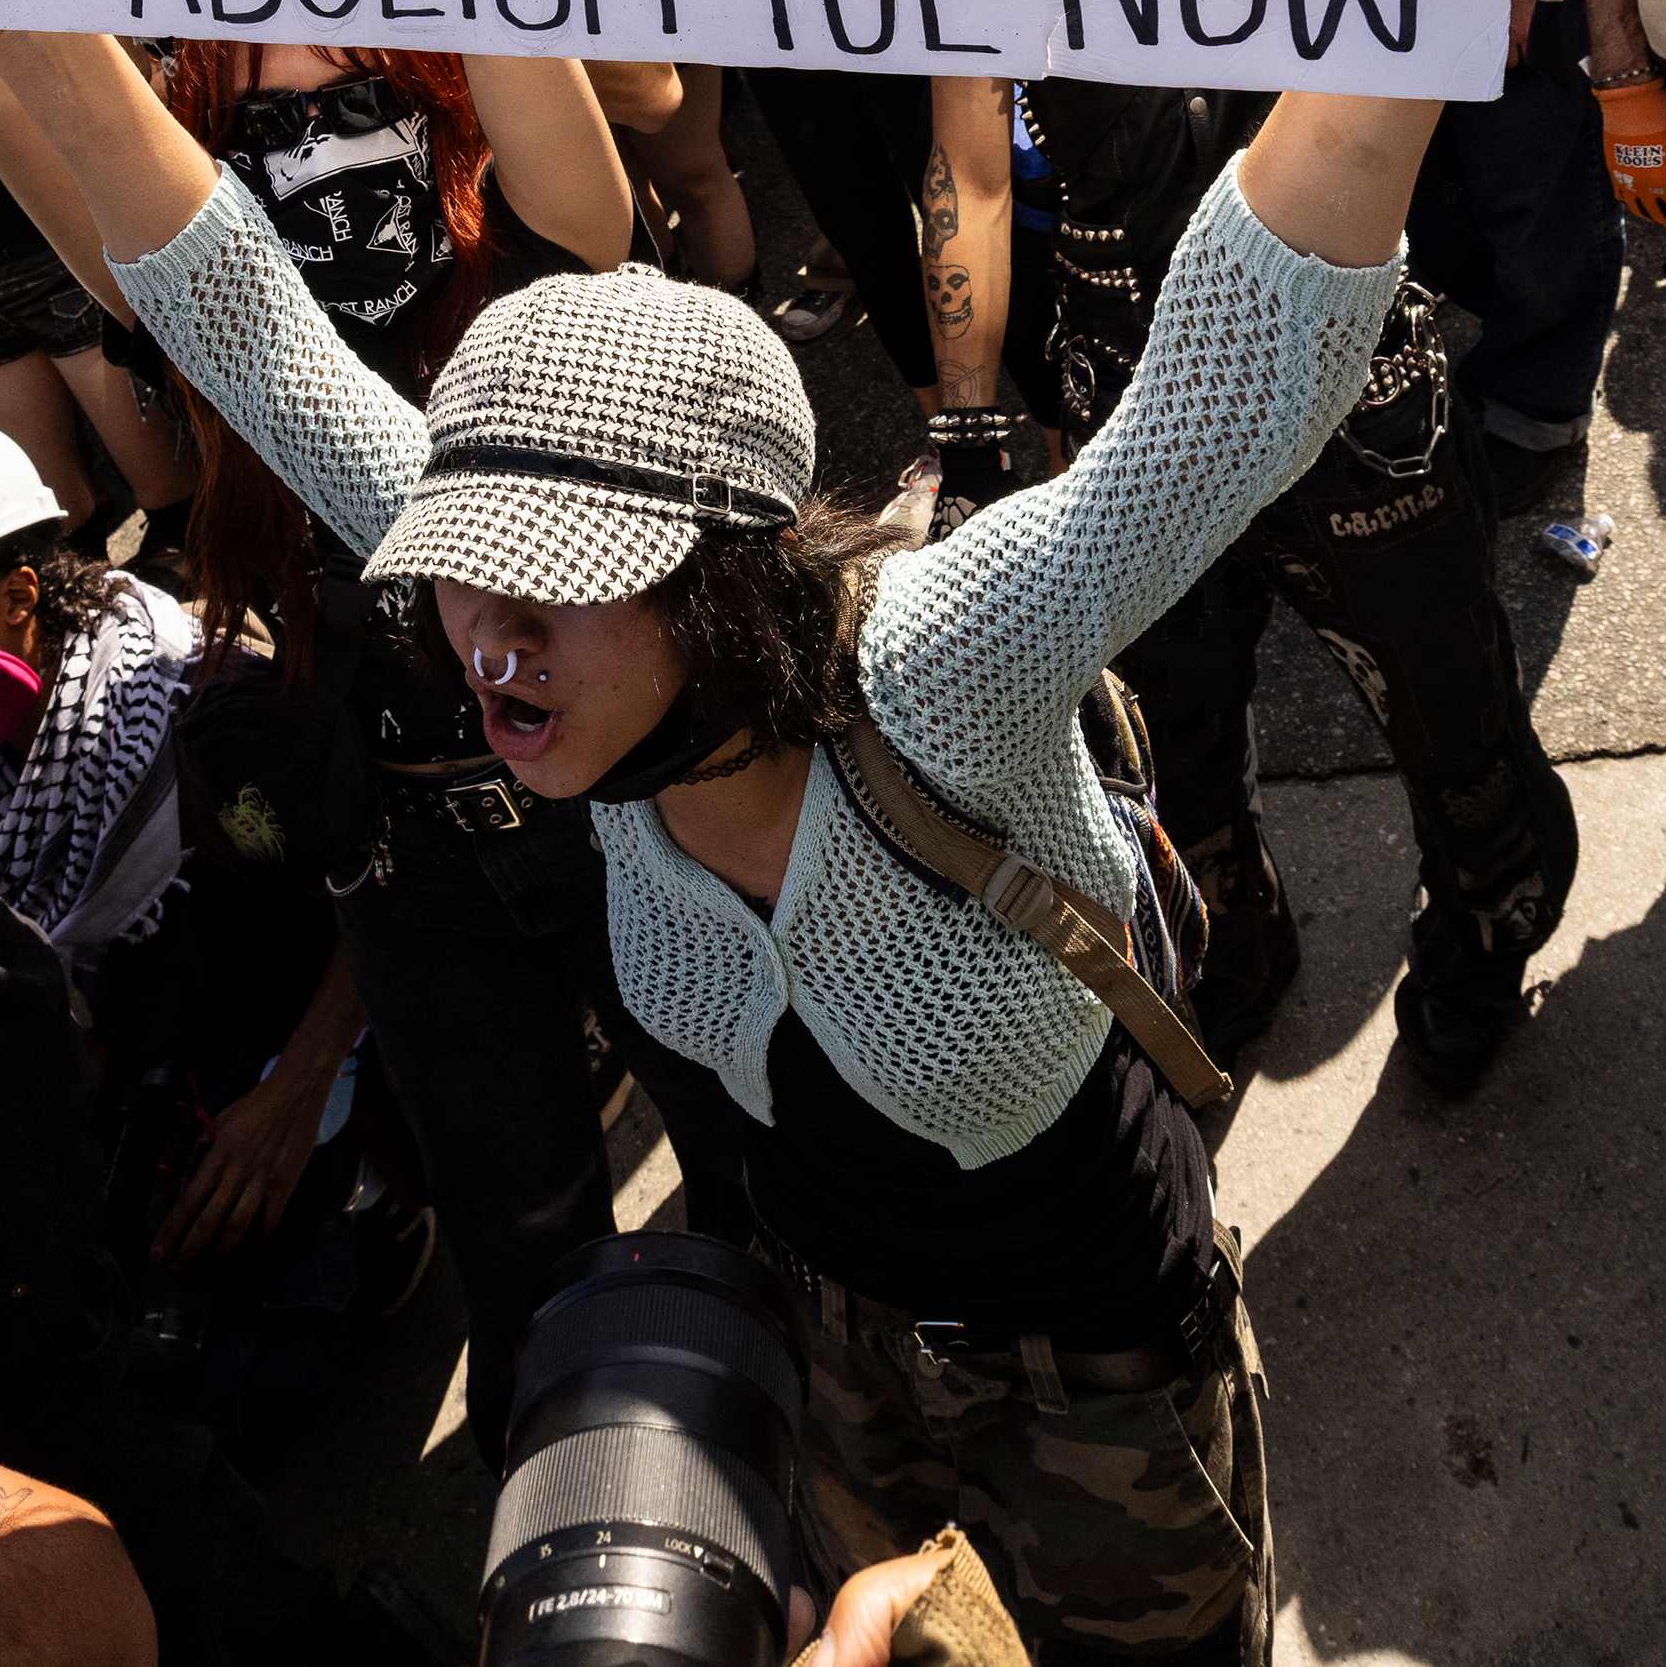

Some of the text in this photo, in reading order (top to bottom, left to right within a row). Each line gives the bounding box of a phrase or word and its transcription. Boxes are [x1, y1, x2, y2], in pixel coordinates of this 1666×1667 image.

[1615, 145, 1662, 157] KLEIN
[1617, 155, 1662, 167] TOOLS
[364, 280, 418, 313] RANCH
[596, 1531, 612, 1545] 24
[664, 1537, 693, 1556] LOCK
